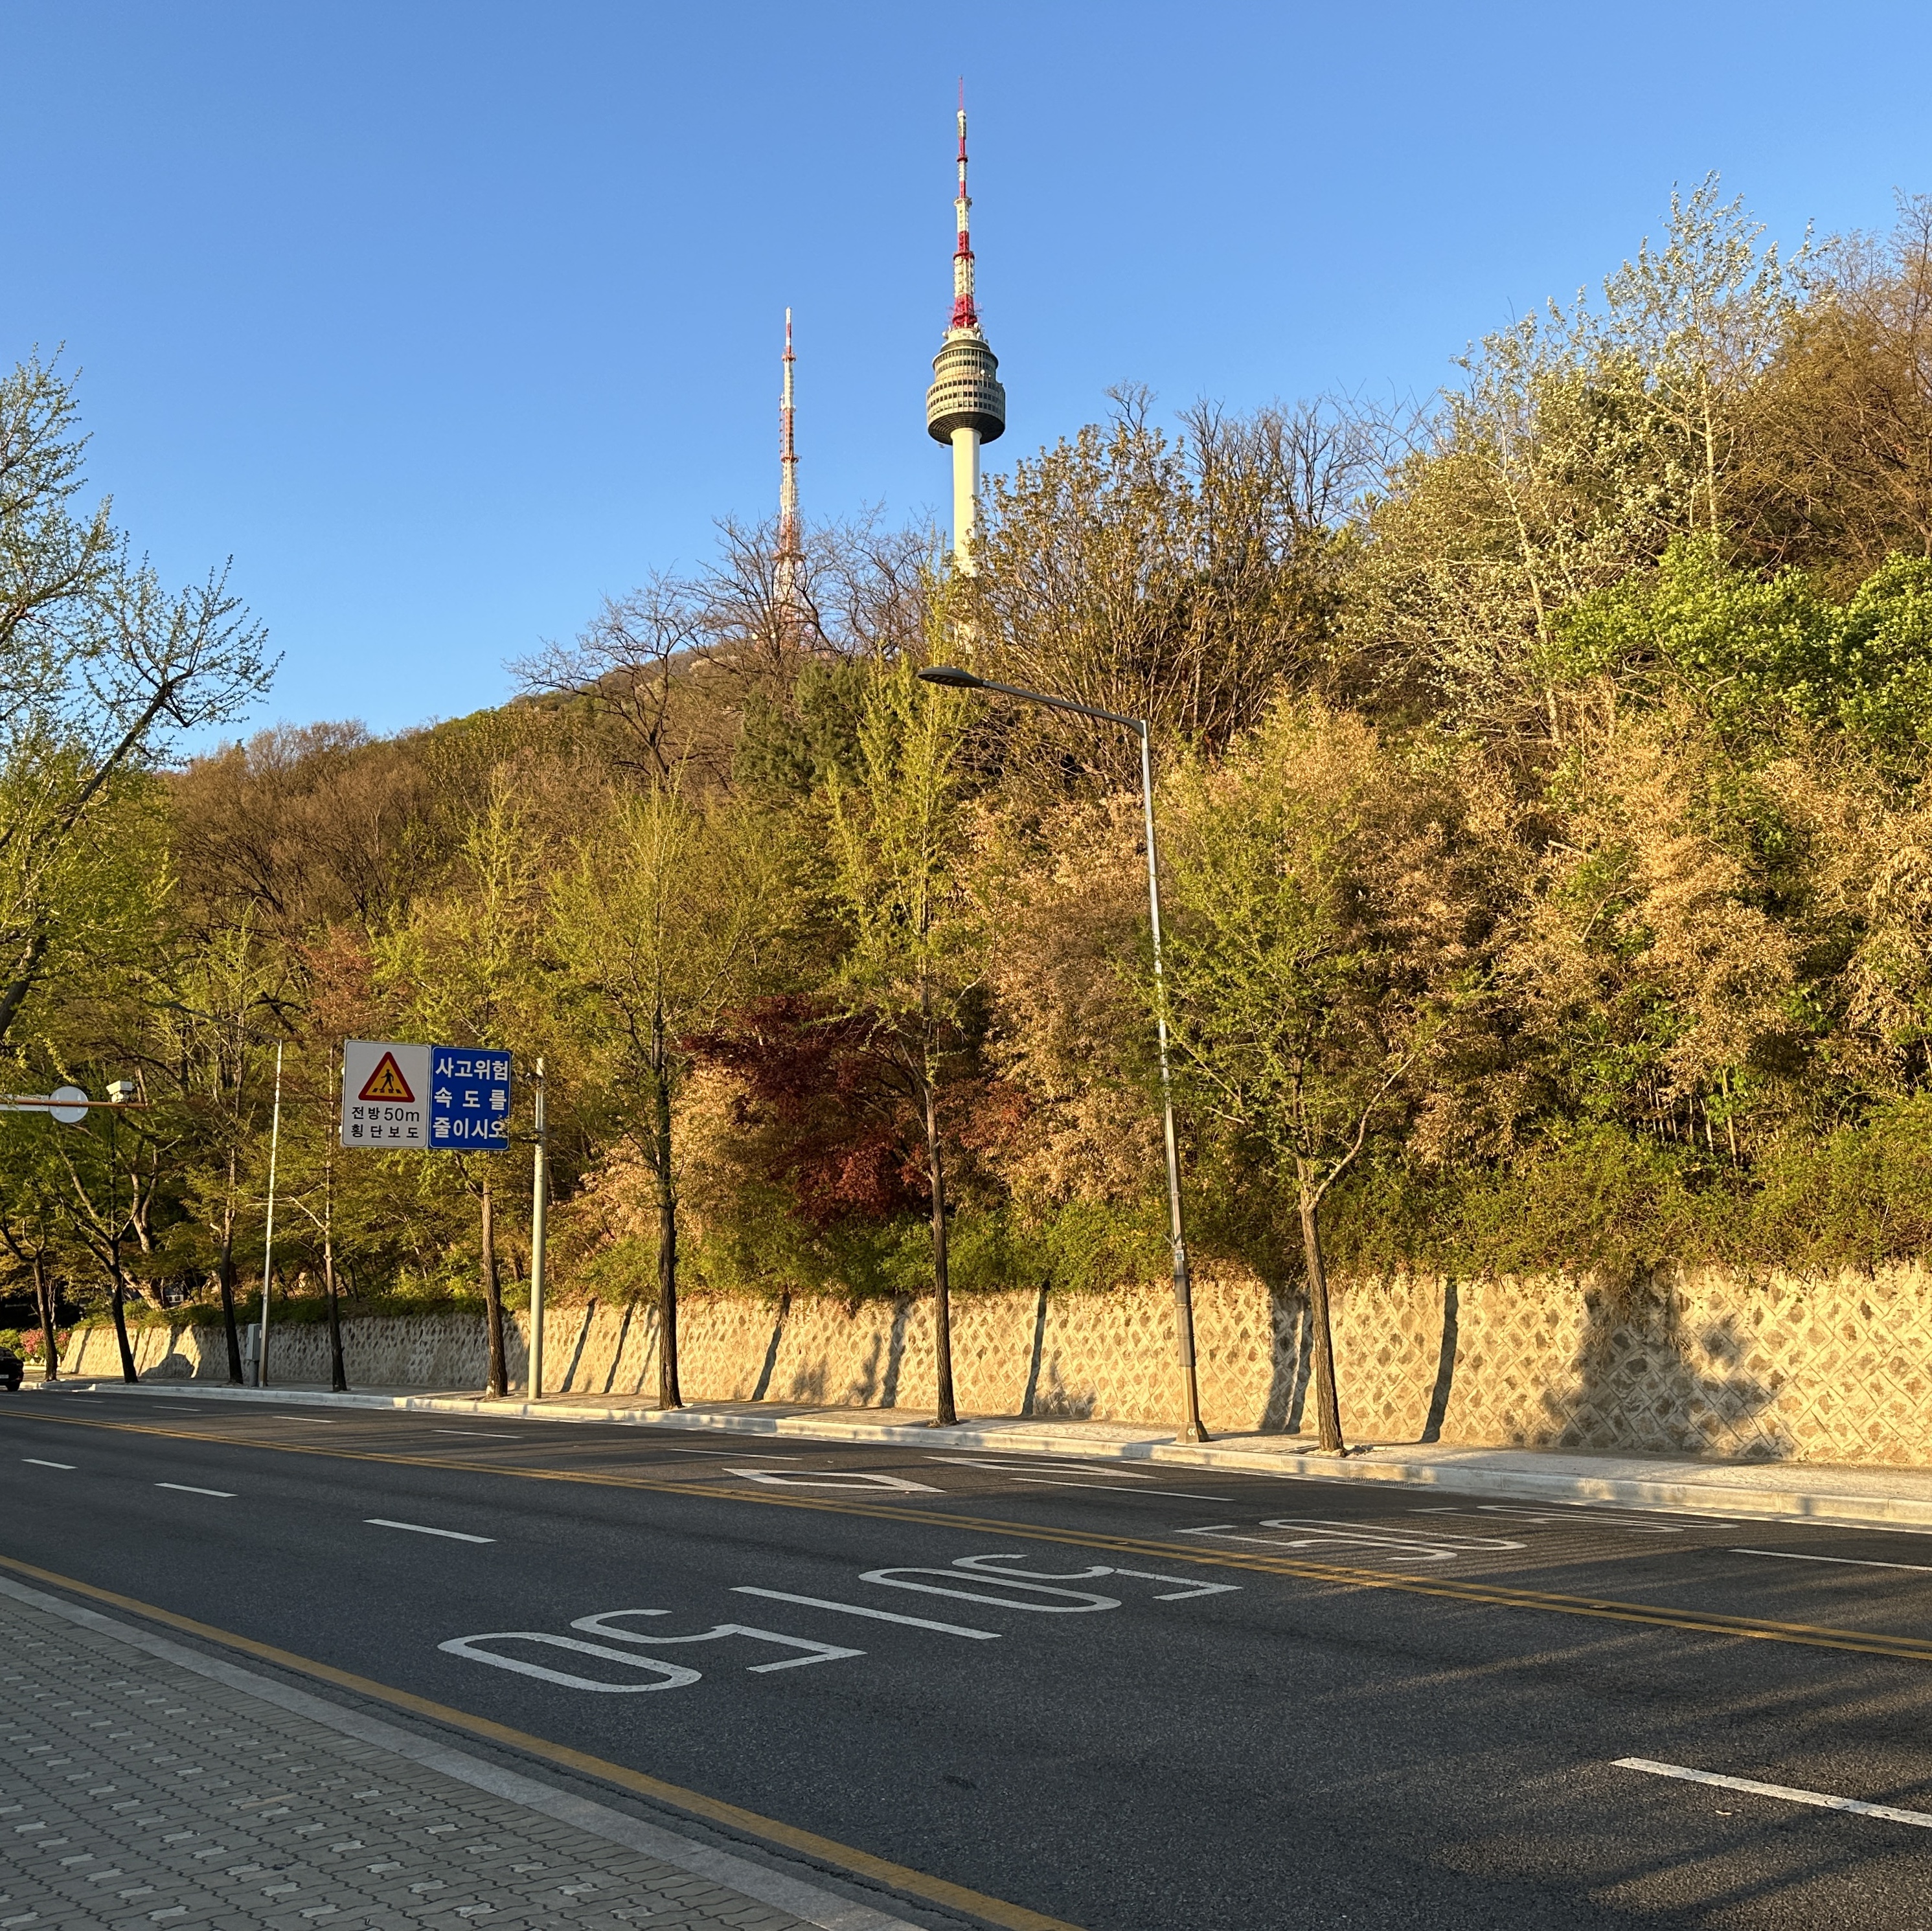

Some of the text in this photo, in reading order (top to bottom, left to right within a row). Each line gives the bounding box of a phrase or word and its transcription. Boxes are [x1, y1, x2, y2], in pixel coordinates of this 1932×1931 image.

[435, 1057, 508, 1081] 사고위험
[434, 1087, 506, 1111] 속도를
[352, 1106, 420, 1122] 전방 50m
[351, 1124, 419, 1138] 횡단보도
[433, 1117, 508, 1140] 줄이시오
[1409, 1505, 1740, 1533] 50
[1174, 1519, 1528, 1561] 50
[858, 1554, 1243, 1612] 50
[438, 1609, 868, 1693] 50
